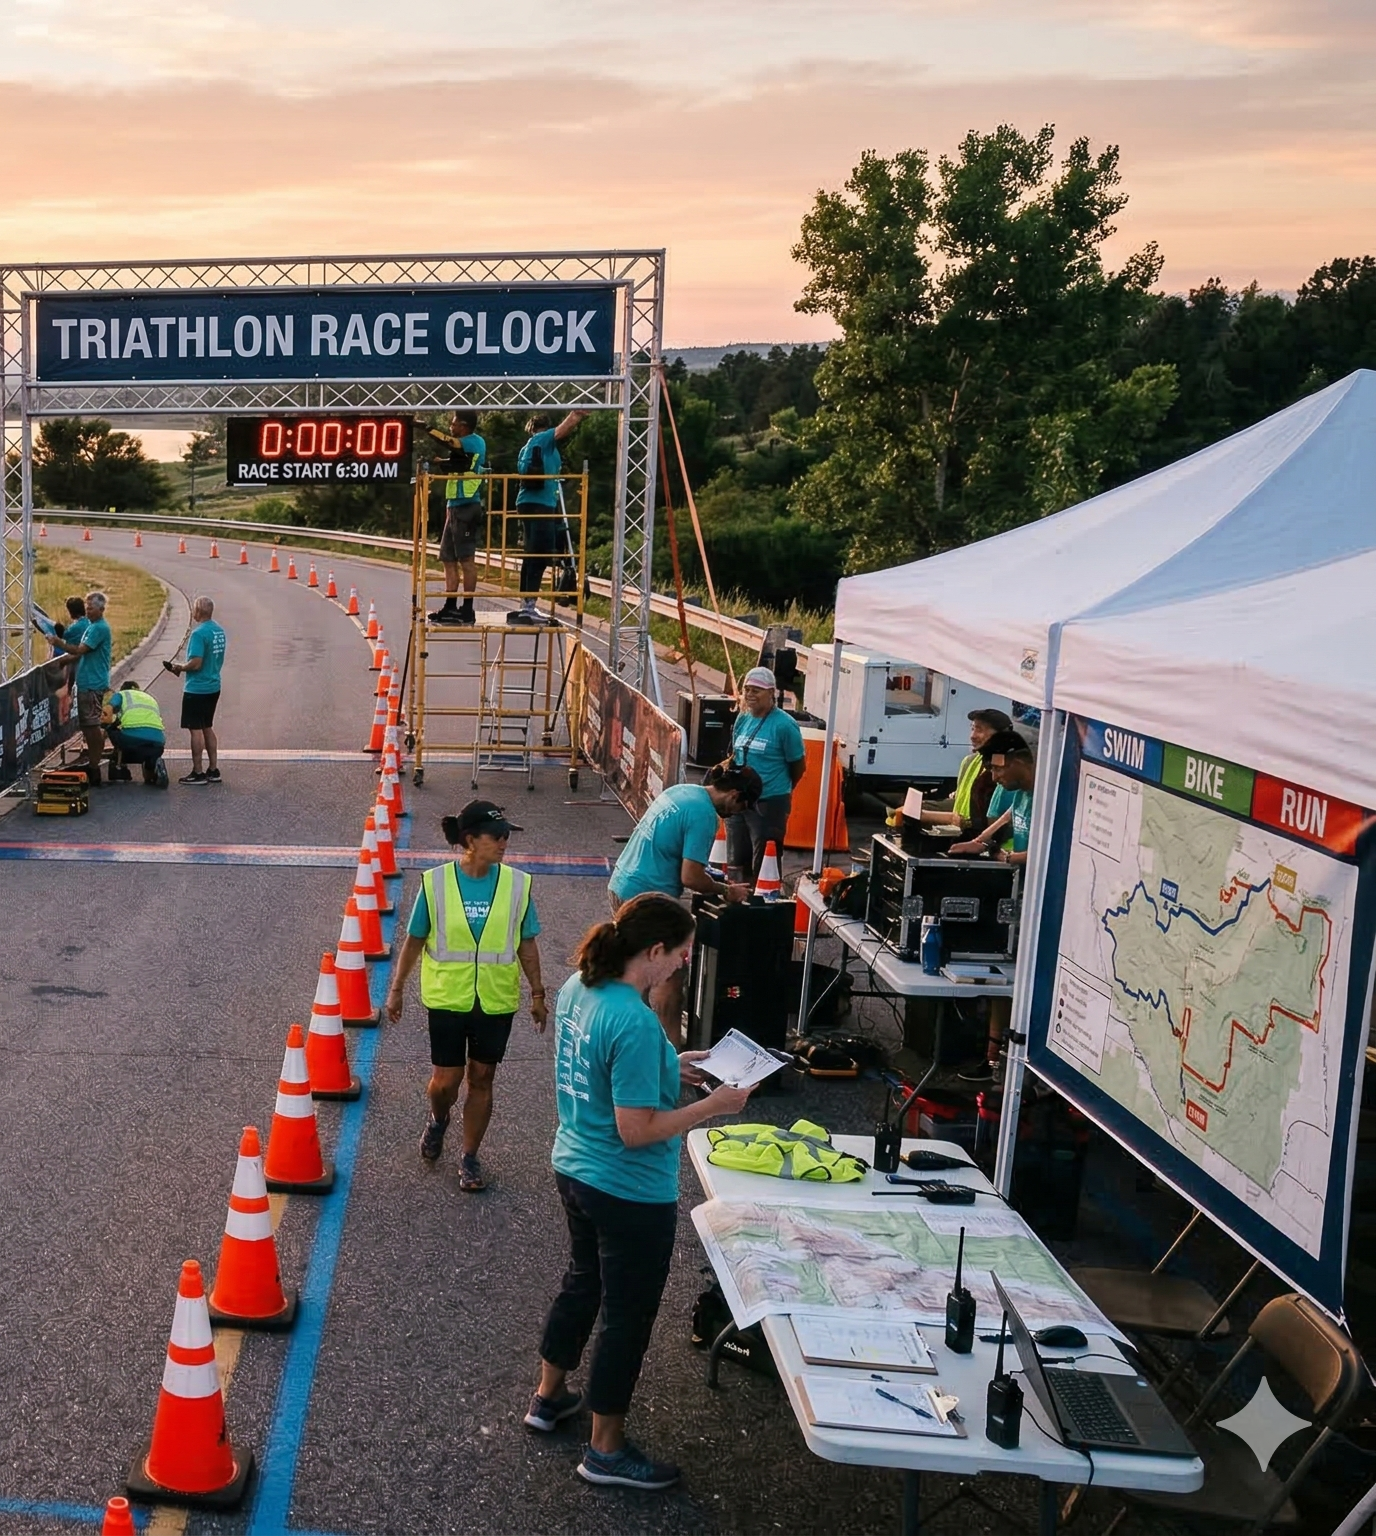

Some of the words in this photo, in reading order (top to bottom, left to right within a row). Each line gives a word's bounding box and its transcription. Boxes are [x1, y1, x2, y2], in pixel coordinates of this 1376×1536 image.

[52, 315, 294, 360] TRIATHLON
[311, 312, 428, 356] RACE
[445, 310, 597, 355] CLOCK
[262, 423, 402, 456] 0:00:00
[238, 463, 279, 479] RACE
[283, 463, 332, 478] START
[336, 462, 369, 478] 6:30
[373, 462, 398, 478] AM
[1103, 728, 1145, 771] SWIM
[1184, 755, 1225, 800] BIKE
[1280, 787, 1327, 838] RUN
